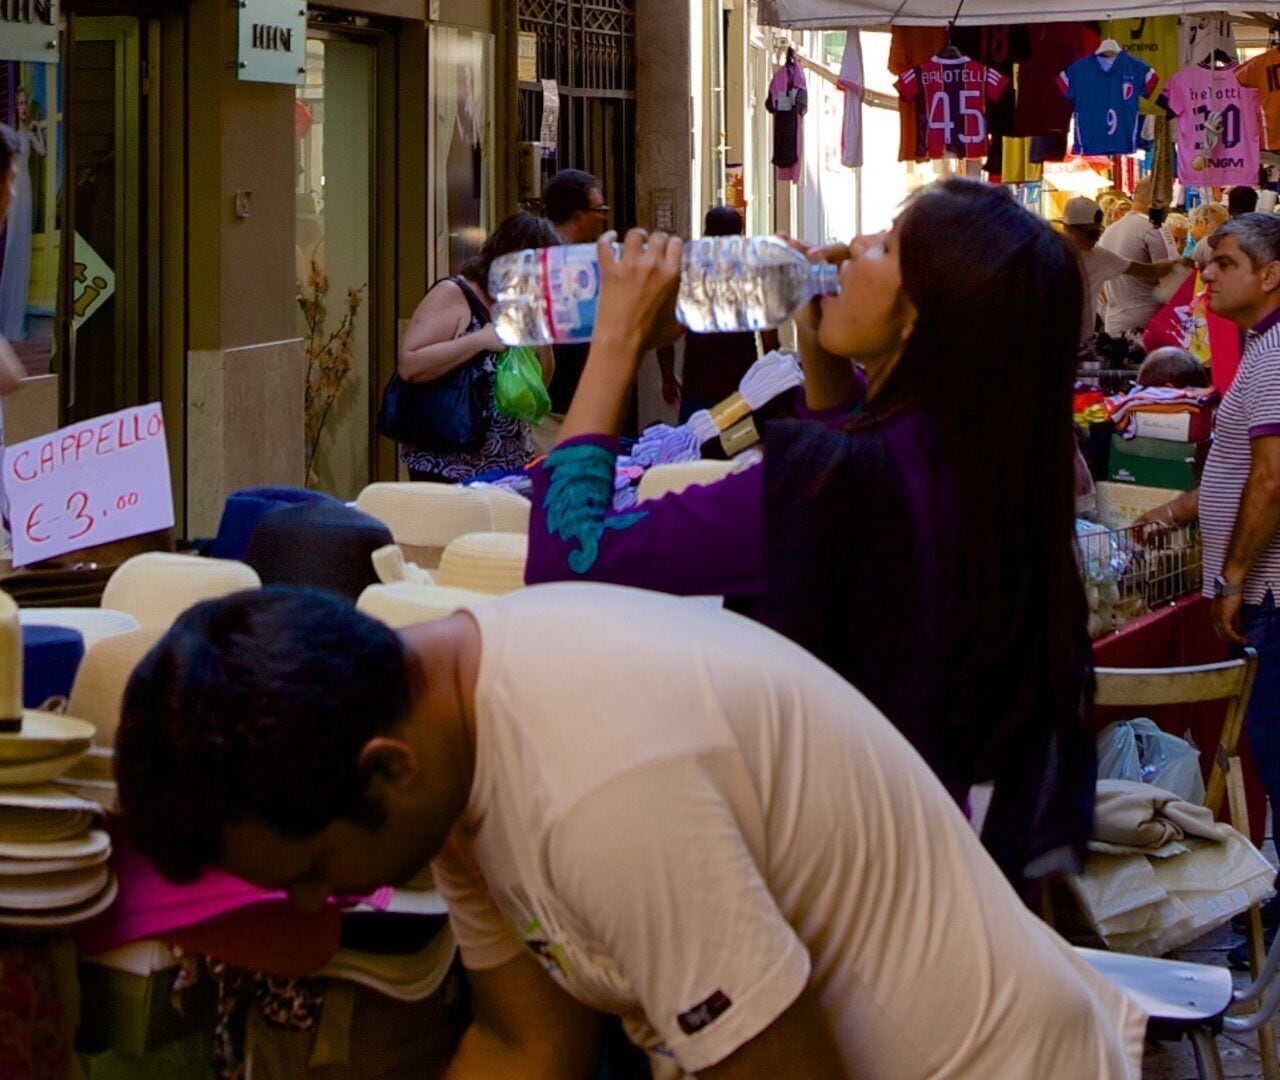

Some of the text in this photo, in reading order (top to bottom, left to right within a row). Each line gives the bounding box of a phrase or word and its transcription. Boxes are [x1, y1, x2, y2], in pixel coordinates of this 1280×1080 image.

[929, 90, 986, 144] 45
[1106, 108, 1118, 135] 9
[1207, 158, 1244, 169] NGM
[13, 413, 163, 481] CAPPELLO
